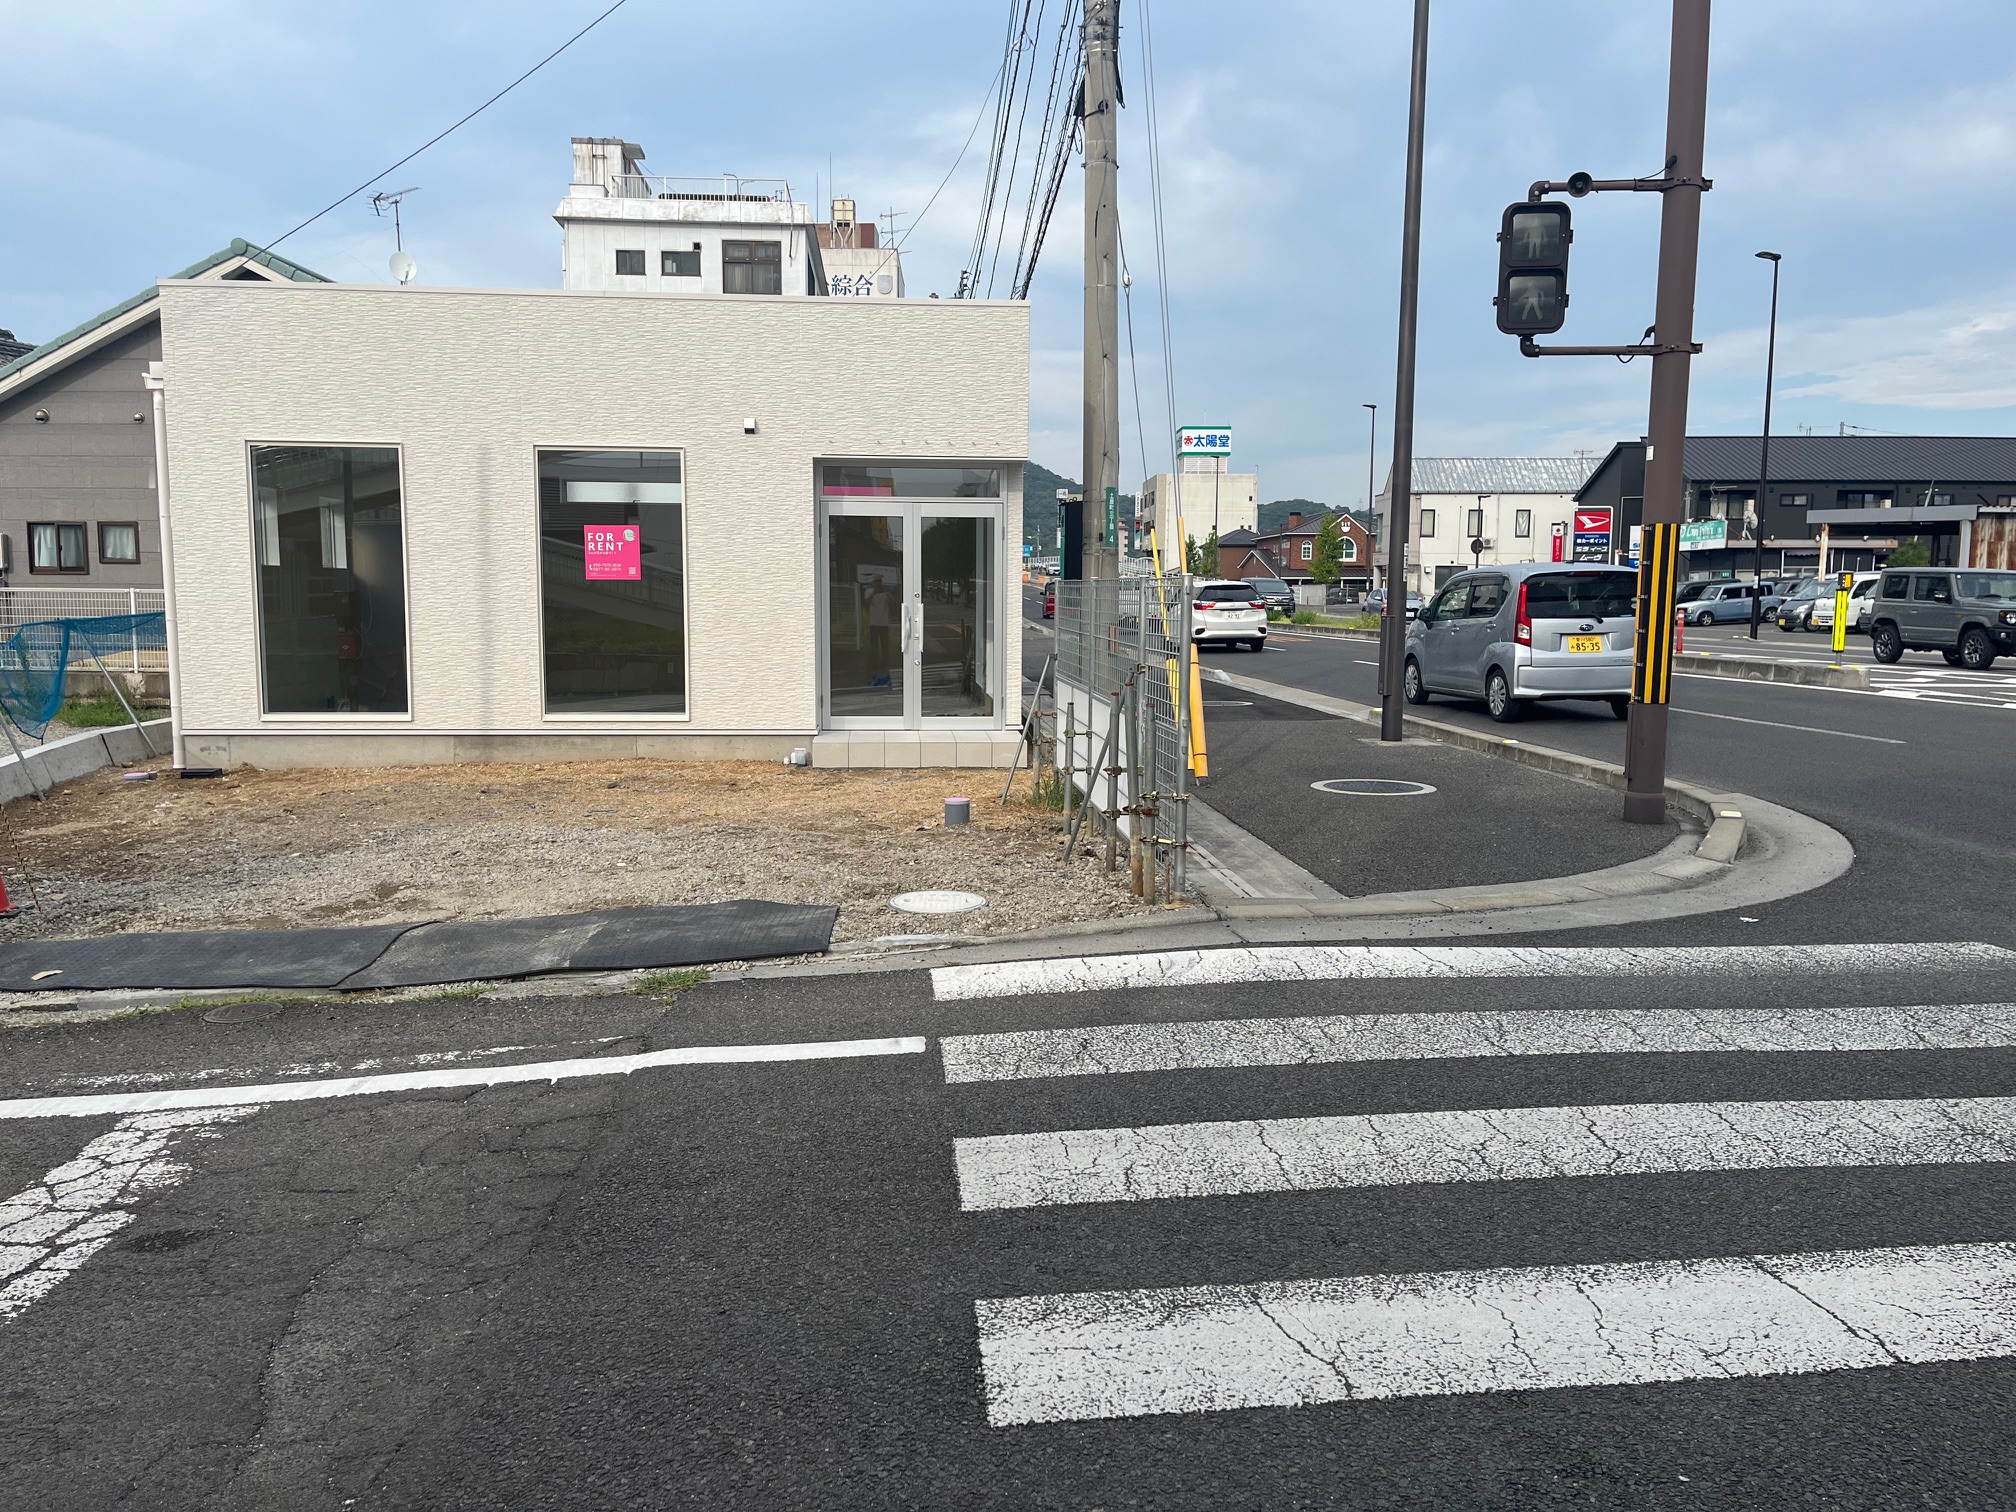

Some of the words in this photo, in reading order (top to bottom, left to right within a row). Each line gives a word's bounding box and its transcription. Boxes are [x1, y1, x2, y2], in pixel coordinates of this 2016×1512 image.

[1193, 434, 1230, 447] 太陽堂
[587, 532, 614, 542] FOR
[1109, 535, 1114, 543] 4
[588, 542, 624, 551] RENT
[1576, 642, 1600, 651] 85-35
